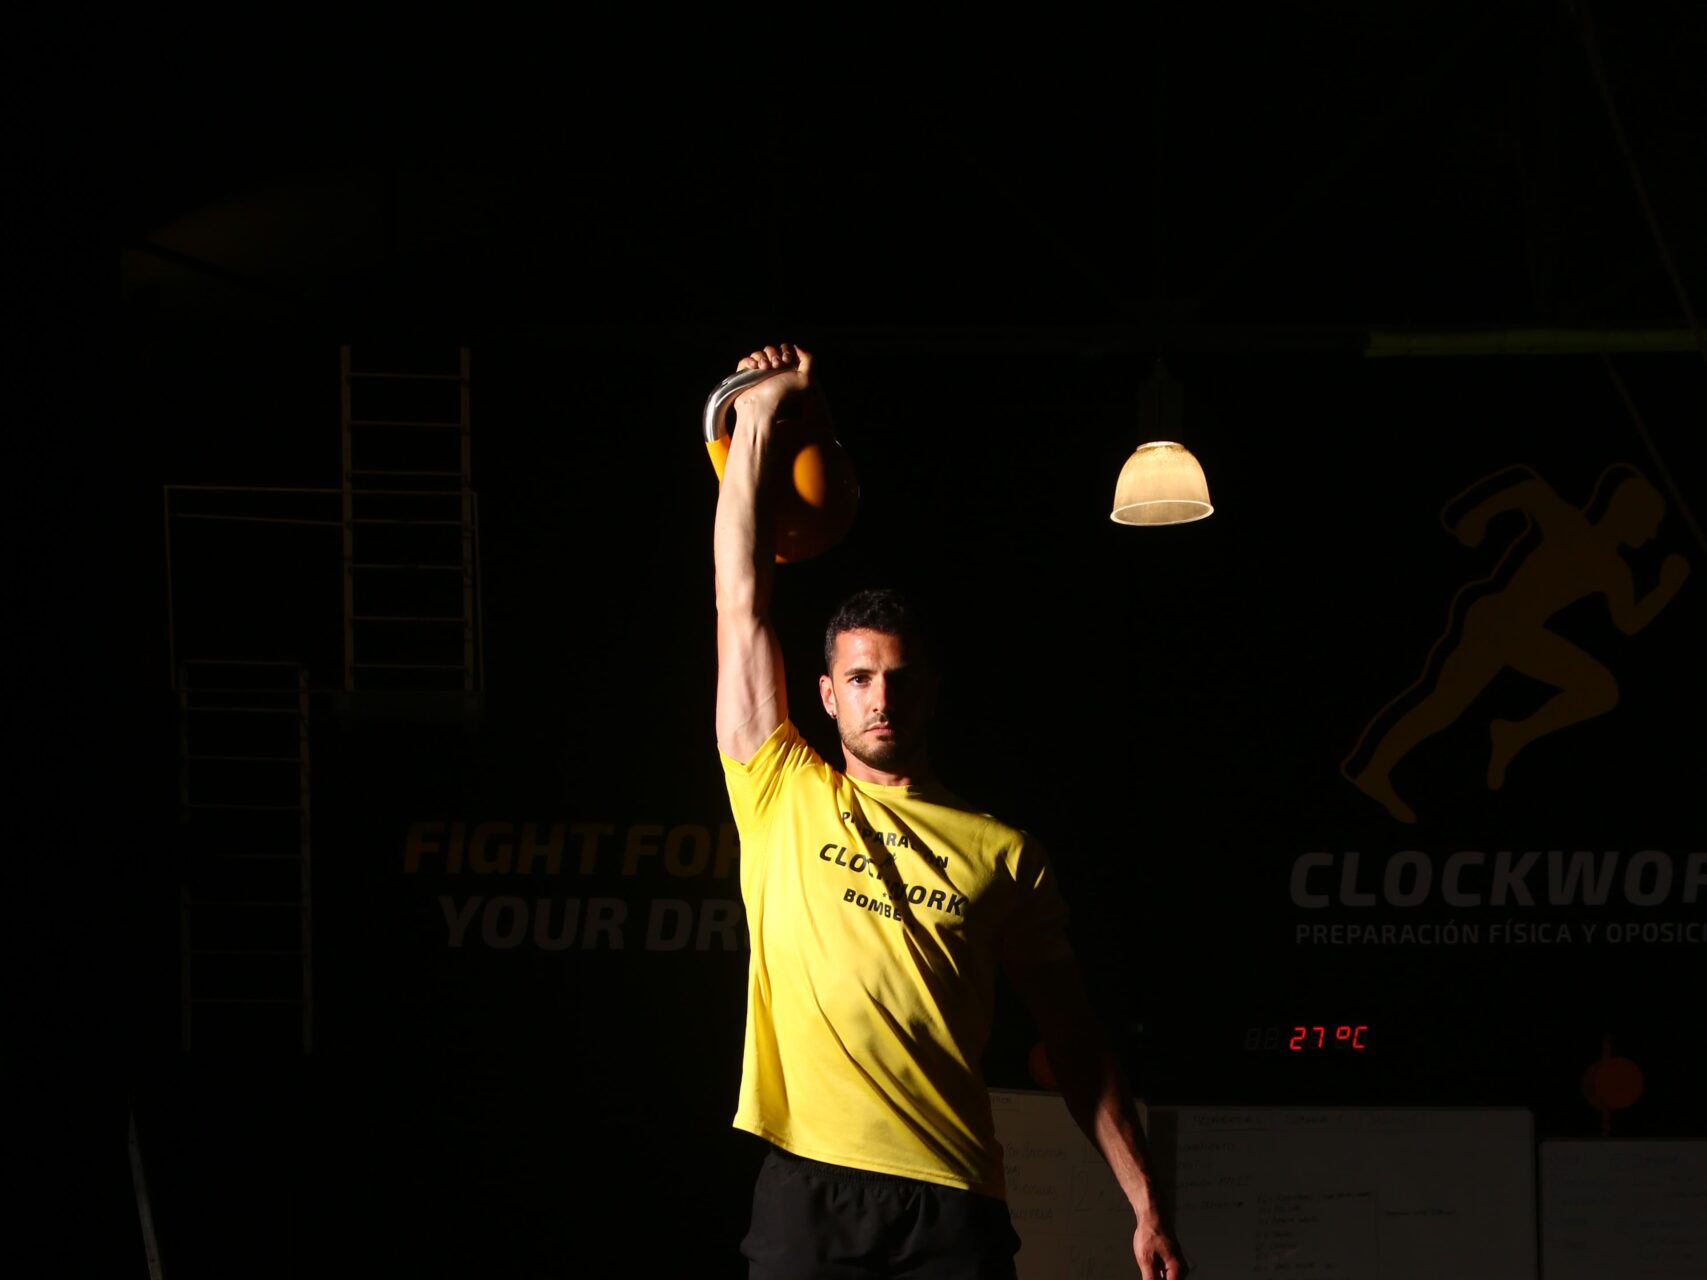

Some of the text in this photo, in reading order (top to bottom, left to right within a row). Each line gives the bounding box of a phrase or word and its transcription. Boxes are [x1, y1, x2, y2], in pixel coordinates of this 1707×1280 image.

[402, 821, 615, 876] FIGHT
[819, 843, 970, 917] CLOWORK
[843, 888, 903, 922] BOMBE
[437, 894, 629, 951] YOUR
[1296, 918, 1480, 945] PREPARACIÓN
[1489, 917, 1574, 944] FÍSICA
[1579, 922, 1598, 944] Y
